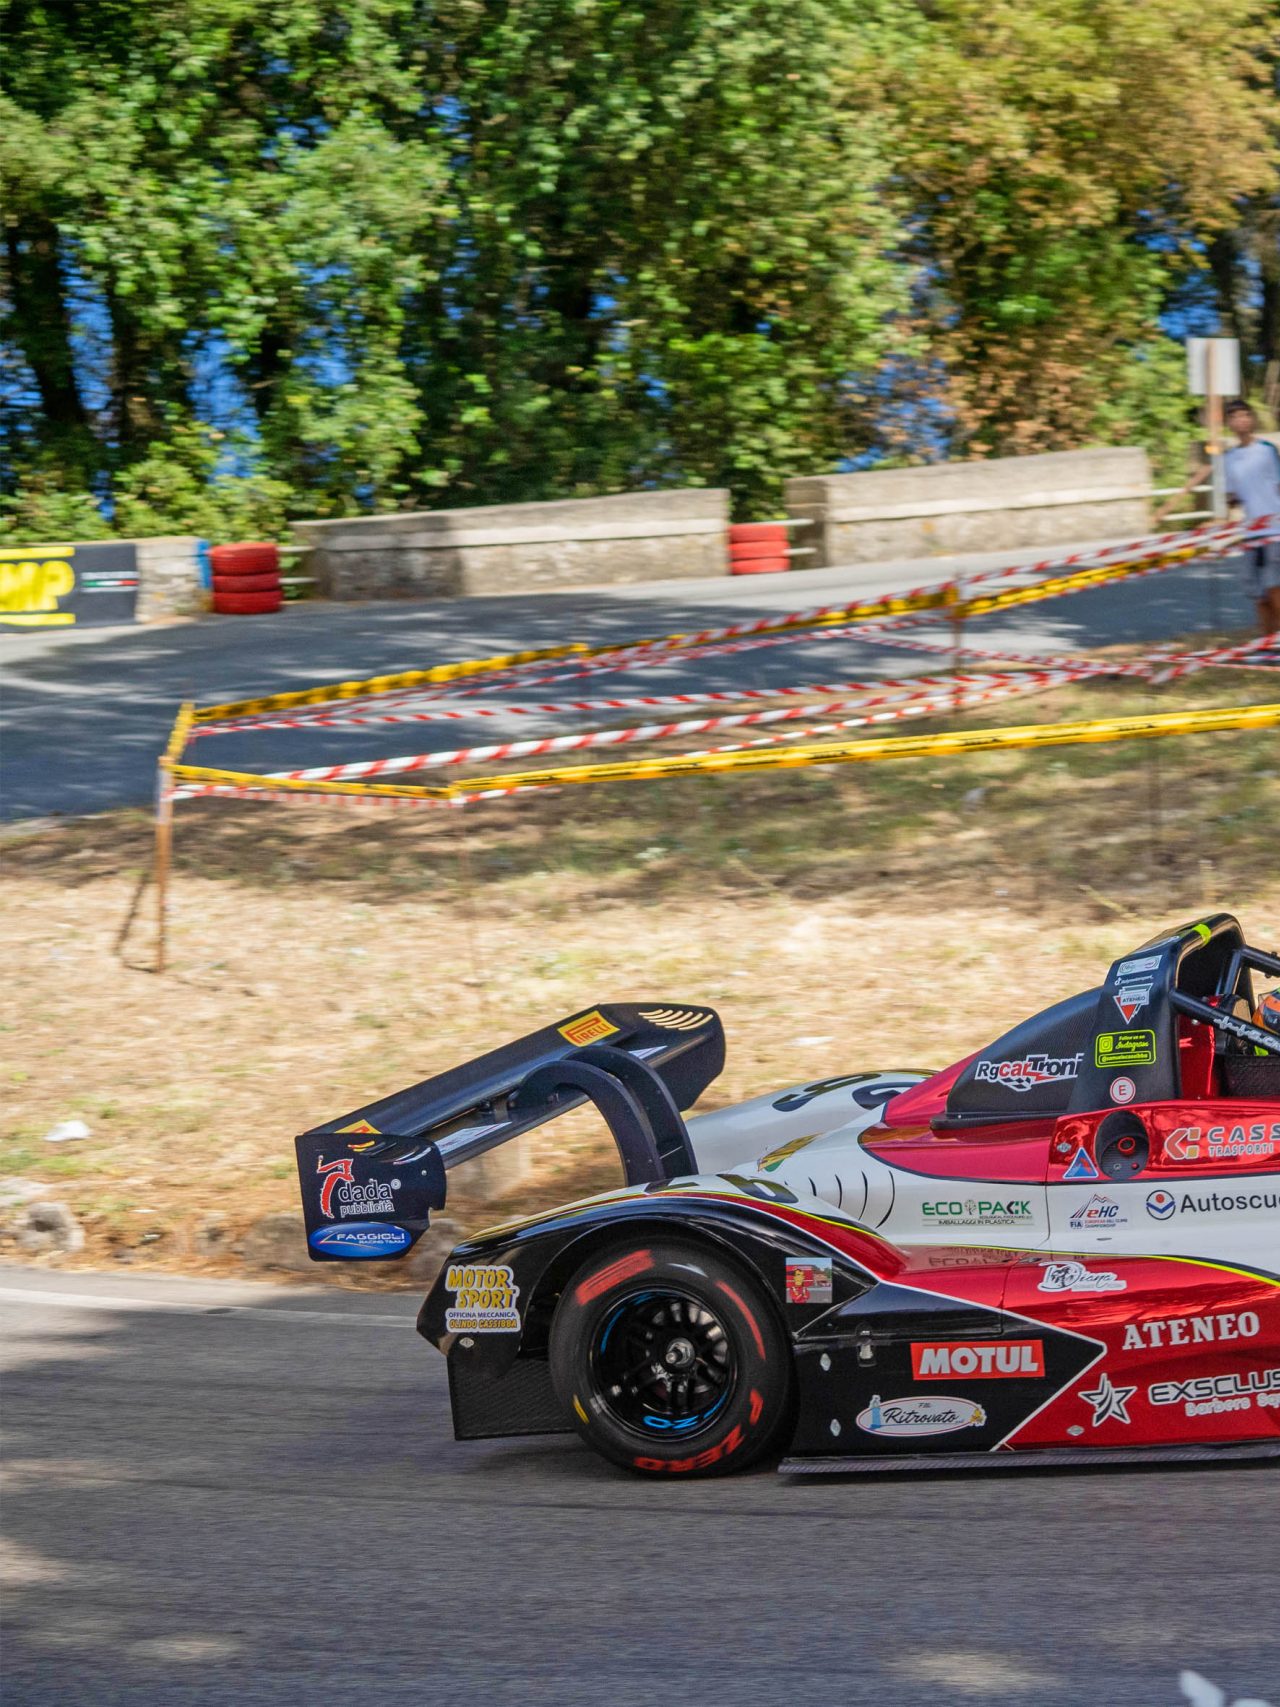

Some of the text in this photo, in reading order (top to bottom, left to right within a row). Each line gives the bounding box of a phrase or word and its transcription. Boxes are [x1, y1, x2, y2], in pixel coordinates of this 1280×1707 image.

[565, 1017, 610, 1044] PIRELLI
[1119, 1085, 1127, 1096] E
[1208, 1143, 1273, 1157] TRASPORTI
[340, 1200, 395, 1218] pubblicità
[336, 1233, 405, 1241] FAGGIOLI
[447, 1268, 511, 1289] MOTOR
[457, 1289, 516, 1309] SPORT
[449, 1319, 517, 1329] OLINDO CASSIBBA
[1122, 1311, 1260, 1351] ATENEO
[919, 1345, 1038, 1375] MOTUL
[883, 1407, 959, 1424] Ritrovato
